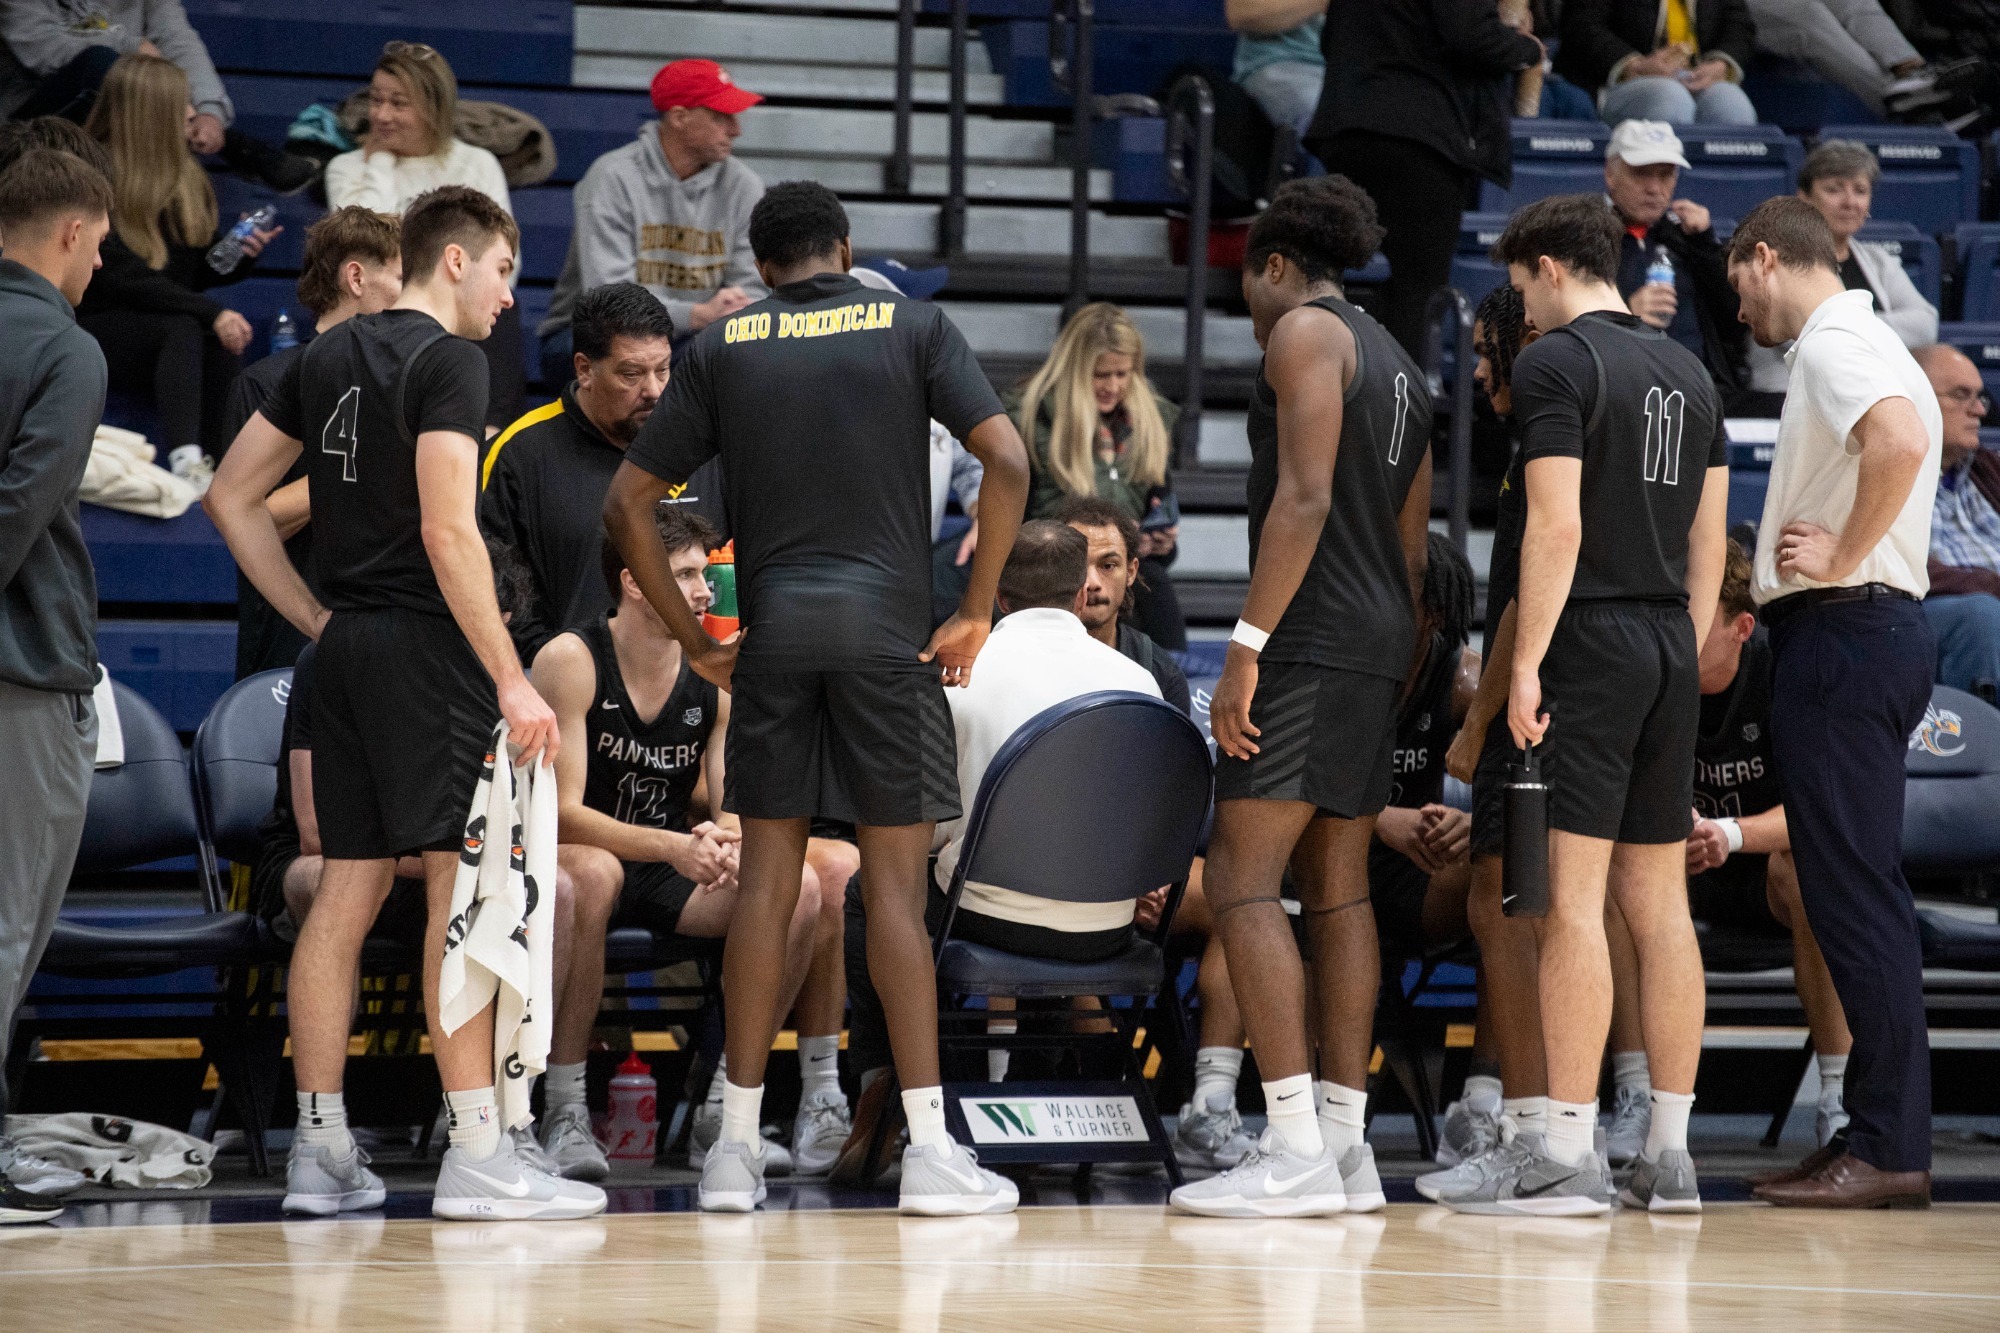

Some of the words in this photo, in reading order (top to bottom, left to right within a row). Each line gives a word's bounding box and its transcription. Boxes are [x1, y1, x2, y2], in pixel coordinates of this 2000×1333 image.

[725, 312, 771, 344] OHIO
[778, 303, 895, 338] DOMINICAN
[322, 386, 360, 482] 4
[1388, 372, 1408, 465] 1
[1644, 386, 1685, 485] 11
[597, 732, 699, 770] PANTHERS
[1393, 747, 1428, 774] ERS
[1697, 755, 1765, 787] THERS
[614, 771, 671, 827] 12
[1054, 1124, 1062, 1136] &
